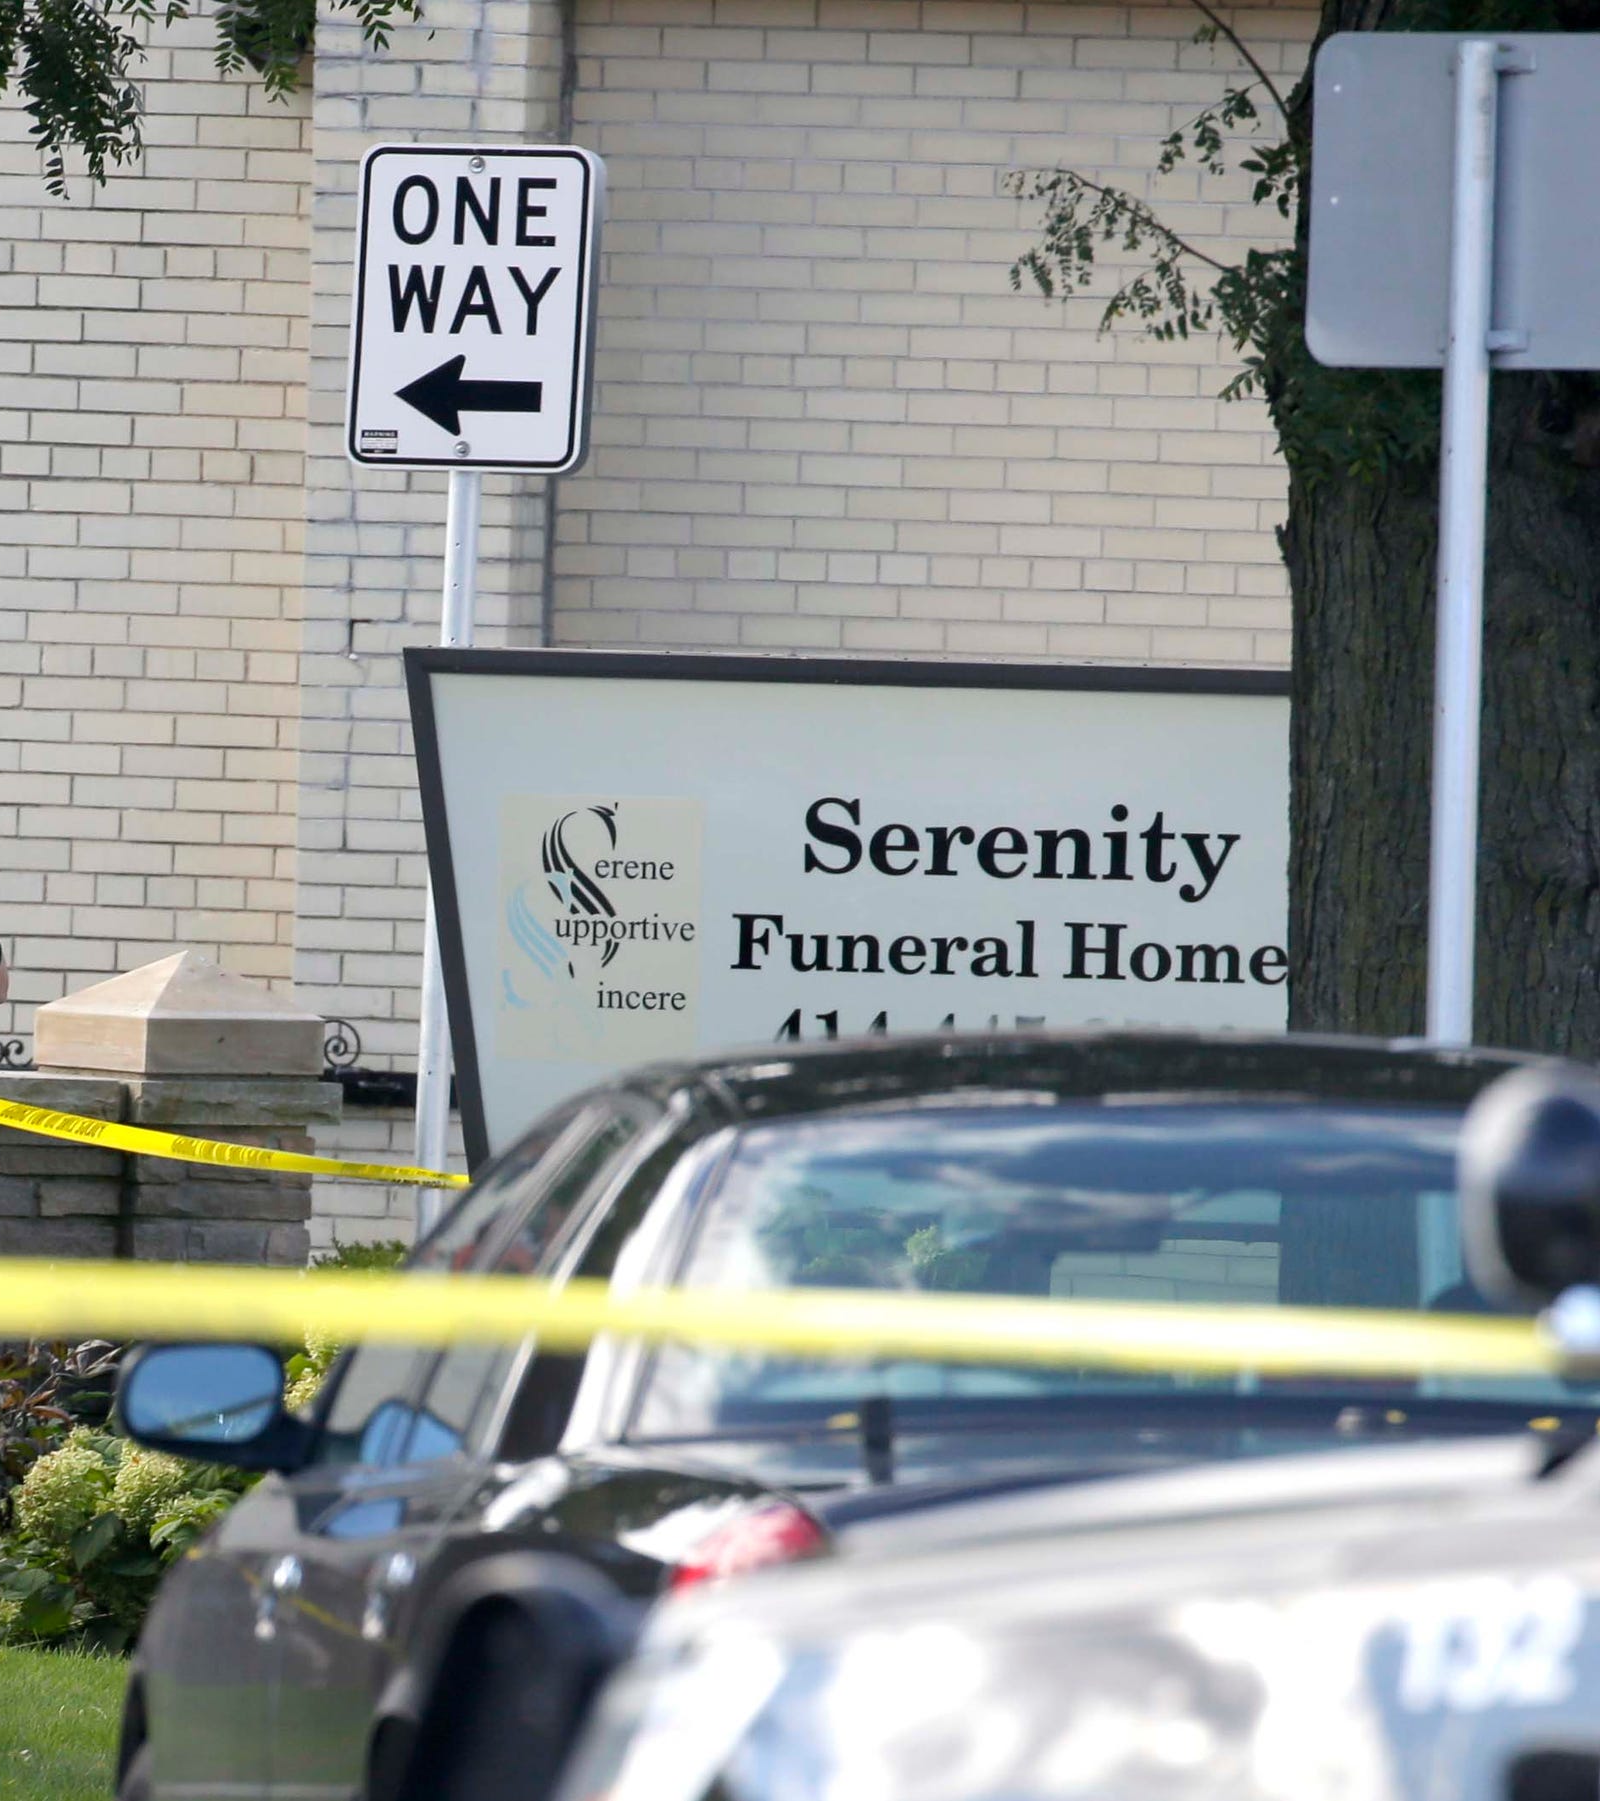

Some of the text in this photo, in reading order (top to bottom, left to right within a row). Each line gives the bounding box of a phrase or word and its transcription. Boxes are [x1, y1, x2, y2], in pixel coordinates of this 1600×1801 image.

[393, 174, 557, 247] ONE
[388, 264, 562, 335] WAY
[804, 797, 1241, 903] Serenity
[730, 913, 1289, 985] Funeral Home
